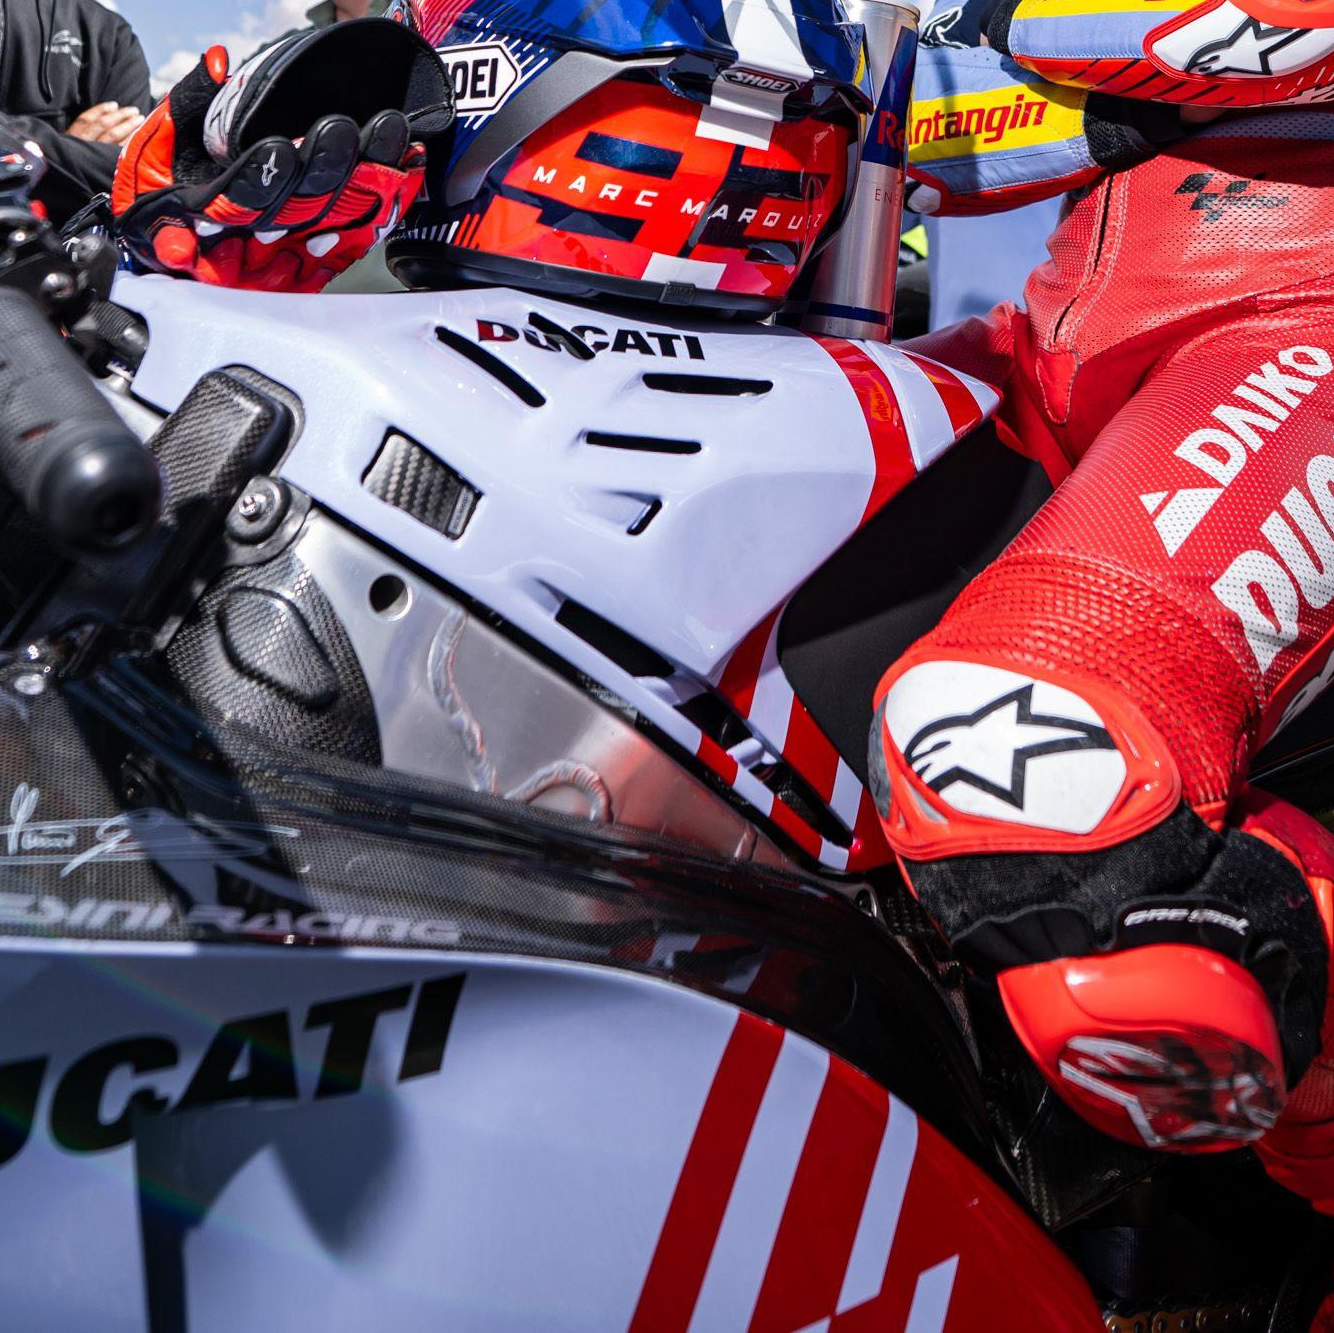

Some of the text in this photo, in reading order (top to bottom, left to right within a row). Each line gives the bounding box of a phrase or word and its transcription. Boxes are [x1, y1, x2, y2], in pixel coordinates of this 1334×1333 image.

[445, 58, 499, 101] OEI
[732, 70, 791, 93] SHOEI
[907, 94, 1049, 144] ntangin
[533, 165, 658, 207] MARC
[477, 319, 705, 361] DUCATI
[1173, 345, 1334, 488] DAIKO
[185, 904, 461, 943] RACING
